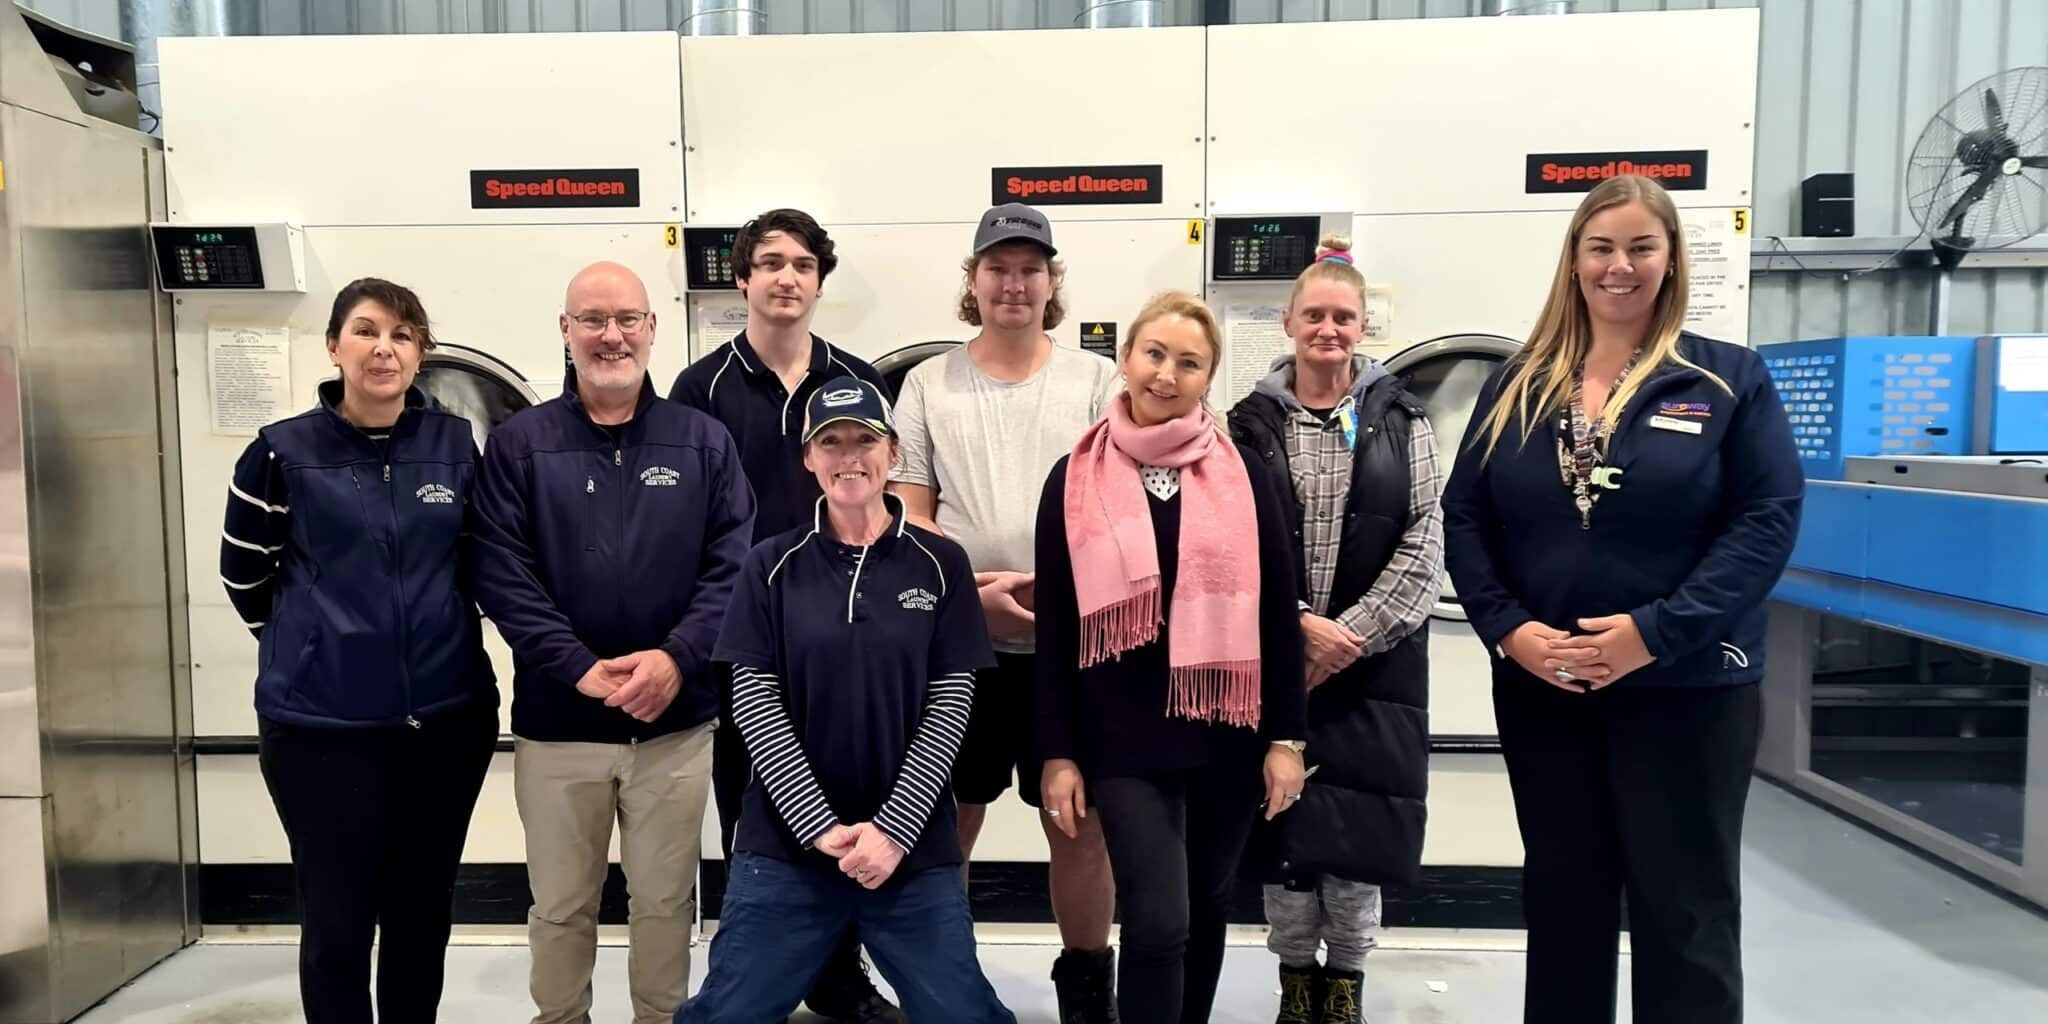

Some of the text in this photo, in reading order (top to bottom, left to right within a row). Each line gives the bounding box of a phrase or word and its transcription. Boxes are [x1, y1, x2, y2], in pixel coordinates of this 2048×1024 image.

[1541, 161, 1692, 183] Speed Queen
[486, 178, 625, 199] Speed Queen
[1007, 175, 1147, 196] Speed Queen
[1735, 210, 1745, 231] 5
[667, 226, 677, 246] 3
[1190, 222, 1200, 242] 4
[640, 467, 680, 480] SOUTH COAST
[416, 484, 455, 498] SOUTH COAST
[898, 588, 938, 604] SOUTH COAST
[902, 602, 934, 611] SERVICES
